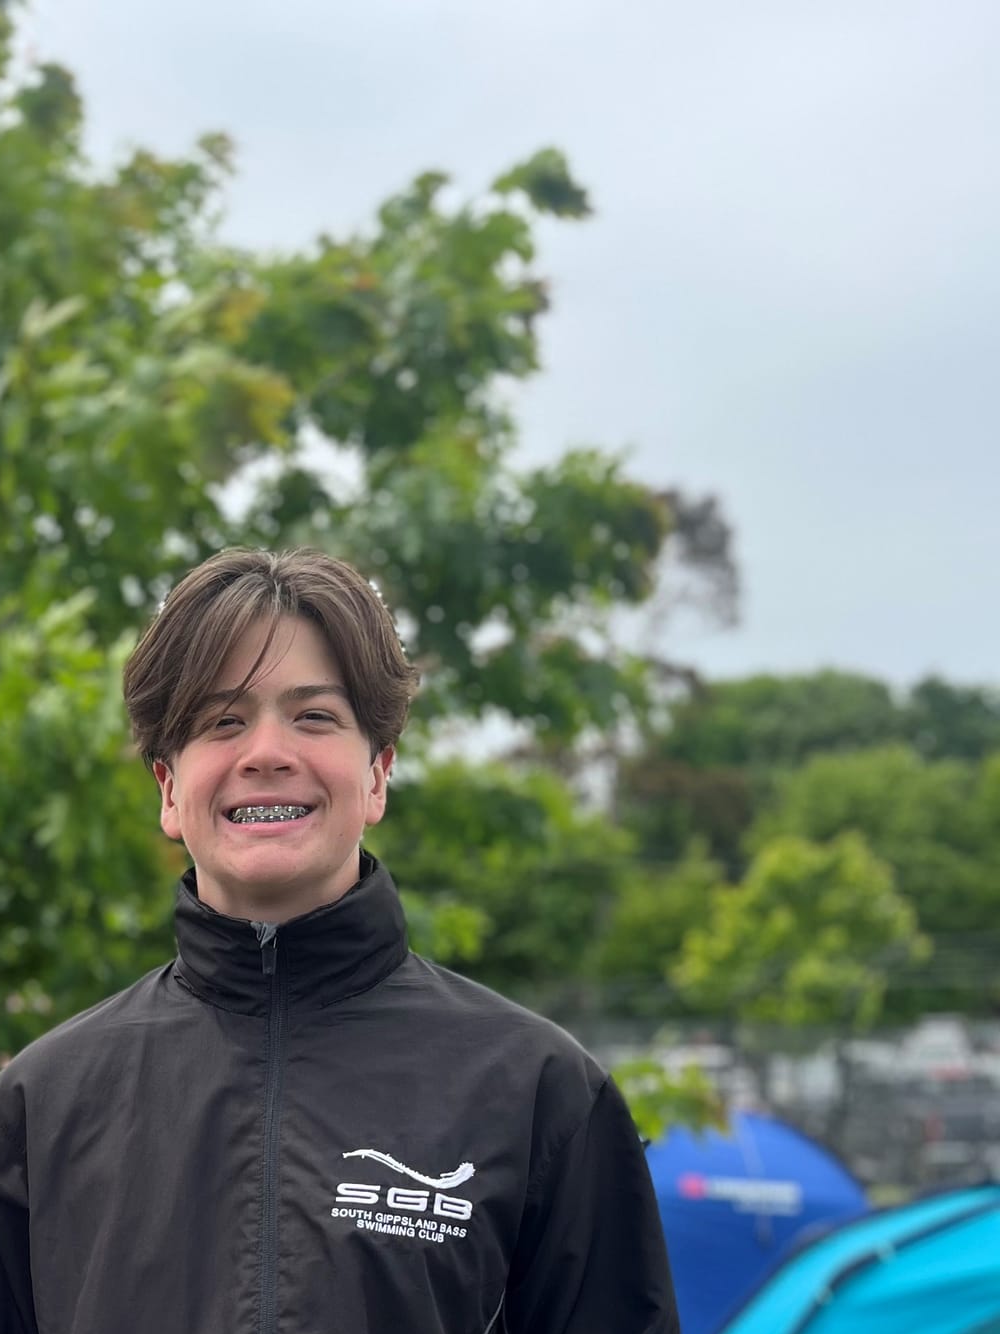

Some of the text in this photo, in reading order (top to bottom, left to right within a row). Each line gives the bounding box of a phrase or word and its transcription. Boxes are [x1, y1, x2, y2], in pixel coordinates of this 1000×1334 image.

[335, 1182, 473, 1221] SGB
[331, 1208, 467, 1238] SOUTH GIPPSLAND BASS
[356, 1219, 445, 1243] SWIMMING CLUB
